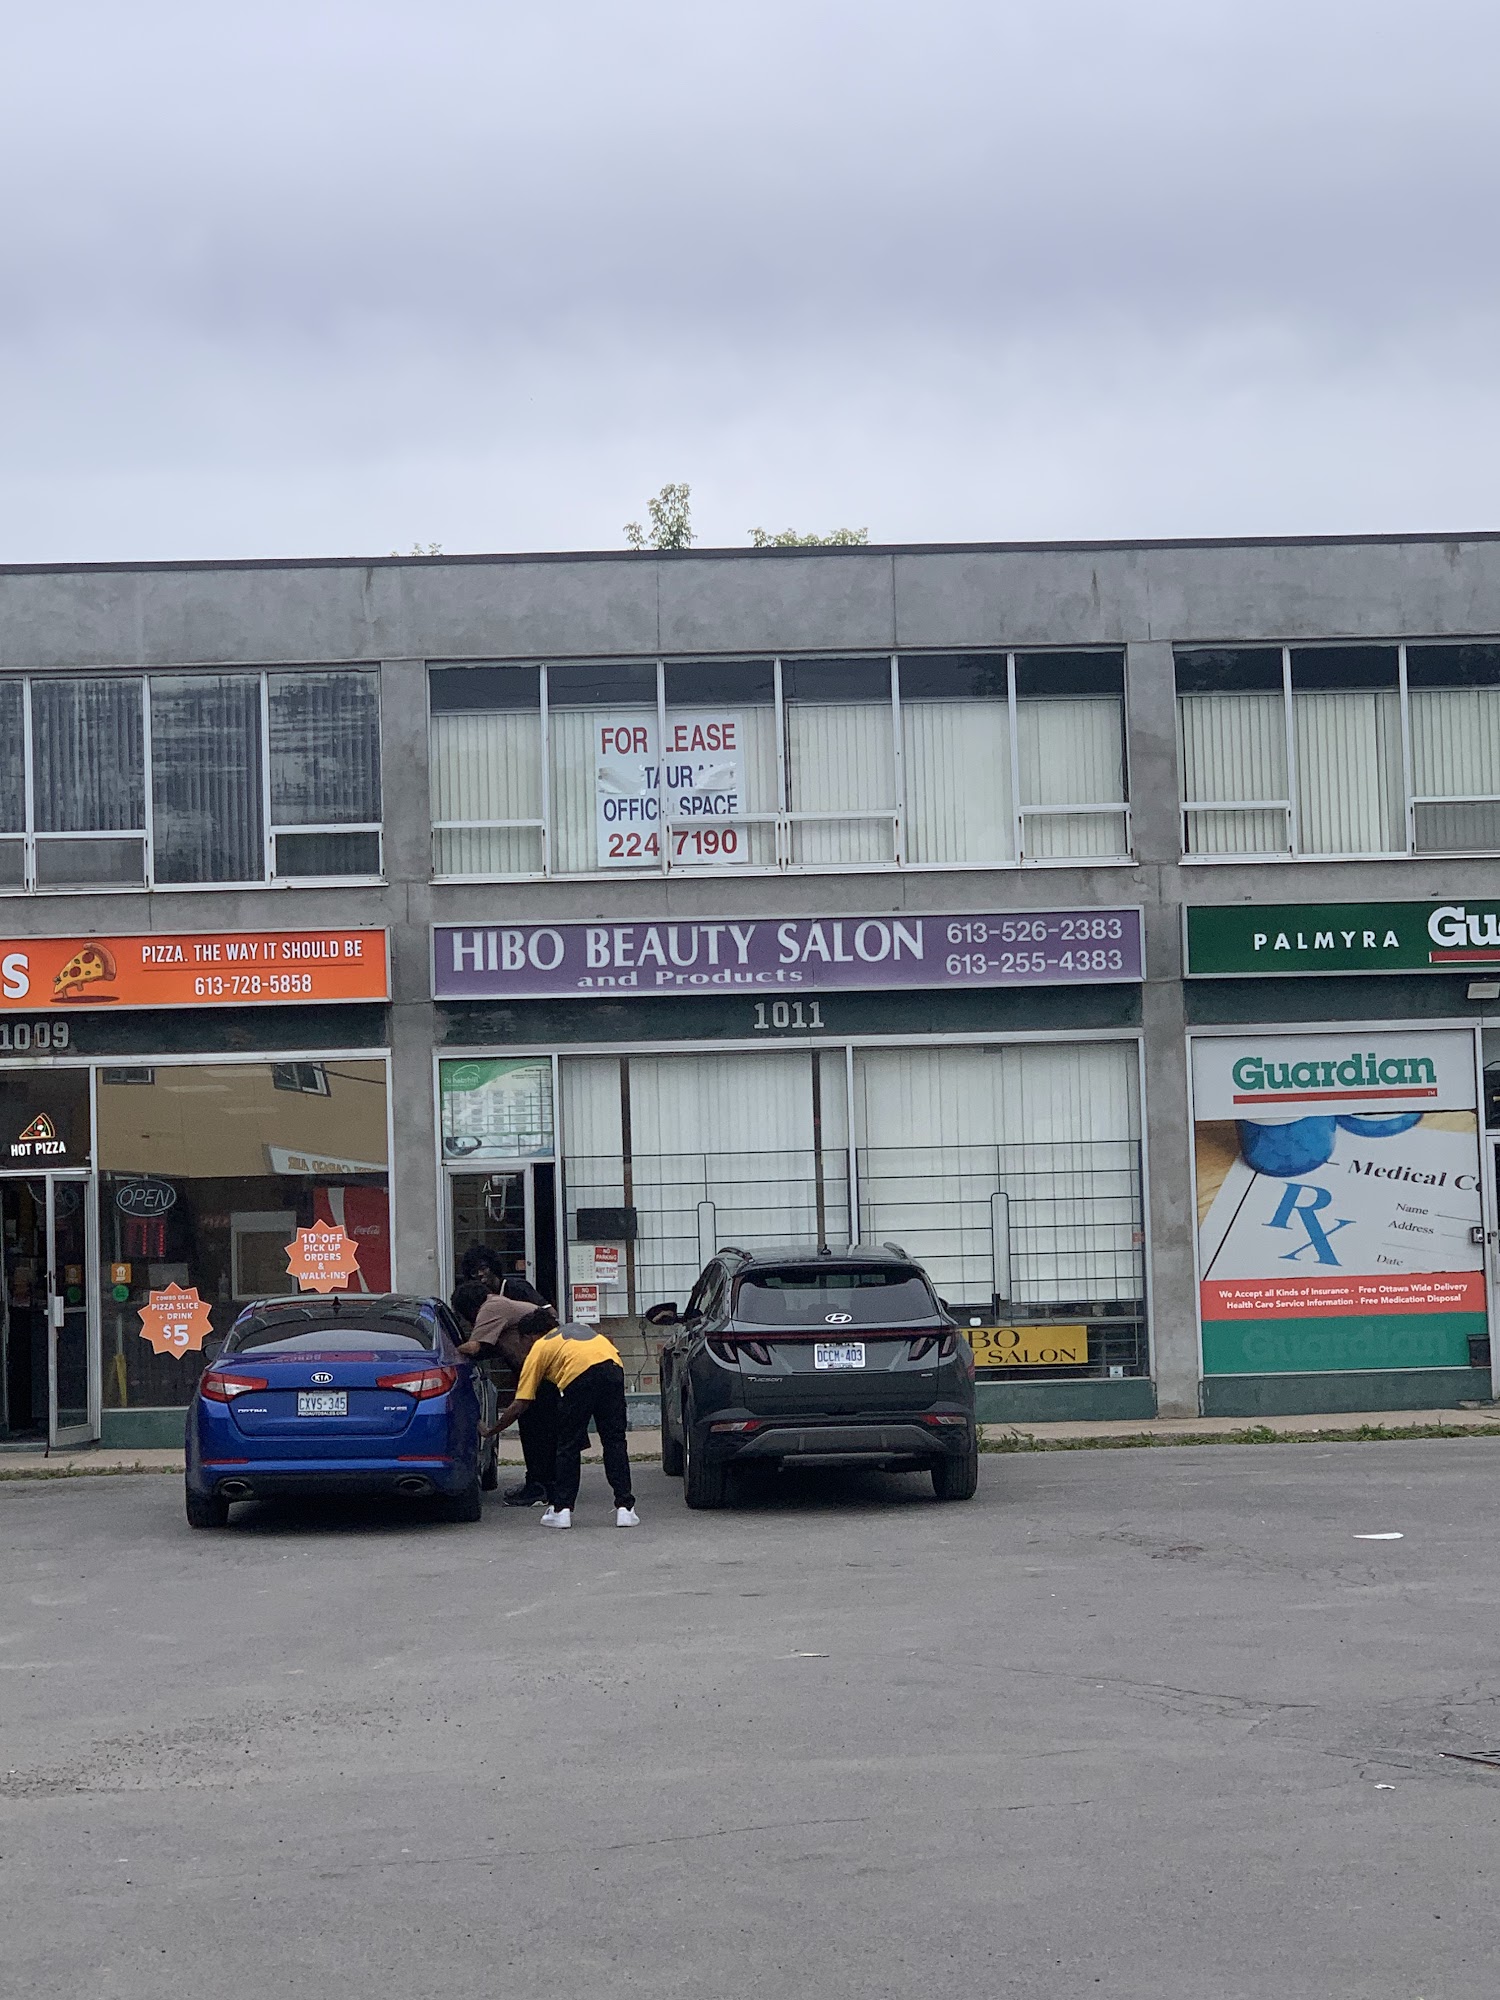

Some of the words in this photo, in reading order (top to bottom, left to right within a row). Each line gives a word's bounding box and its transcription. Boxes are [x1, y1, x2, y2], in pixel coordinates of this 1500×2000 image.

[601, 727, 648, 754] FOR
[603, 798, 662, 821] OFFIC
[679, 794, 739, 815] SPACE
[946, 918, 1124, 944] 613-526-2383
[1427, 906, 1500, 947] Gu
[452, 928, 565, 972] HIBO
[586, 925, 756, 969] BEAUTY
[777, 919, 924, 965] SALON
[1254, 930, 1400, 951] PALMYRA
[142, 945, 188, 963] PIZZA.
[193, 944, 221, 962] THE
[226, 943, 258, 961] WAY
[264, 942, 276, 960] IT
[282, 941, 339, 959] SHOULD
[344, 940, 363, 957] BE
[945, 950, 1124, 975] 613-255-4383
[2, 953, 30, 999] S
[194, 974, 313, 996] 613-728-5858
[577, 971, 638, 988] and
[655, 968, 803, 986] Products
[754, 1001, 825, 1030] 1011
[0, 1021, 69, 1050] 1009
[1232, 1053, 1437, 1090] Guardian
[11, 1143, 31, 1157] HOT
[35, 1141, 66, 1155] PIZZA
[1348, 1159, 1447, 1187] Medical
[120, 1189, 170, 1207] OPEN
[1396, 1203, 1429, 1215] Name
[1388, 1220, 1434, 1235] Address
[304, 1244, 325, 1252] PICK
[328, 1243, 341, 1251] UP
[304, 1253, 341, 1261] ORDERS
[317, 1262, 324, 1270] &
[1377, 1254, 1403, 1266] Date
[300, 1271, 346, 1280] WALK-INS
[1219, 1290, 1232, 1298] We
[1235, 1290, 1262, 1299] Accept
[1265, 1289, 1274, 1297] all
[1276, 1288, 1298, 1297] Kinds
[1301, 1287, 1310, 1295] of
[1311, 1287, 1349, 1295] Insurance
[1379, 1285, 1409, 1293] Ottawa
[1410, 1284, 1432, 1292] Wide
[1434, 1283, 1467, 1292] Delivery
[151, 1303, 174, 1311] PIZZA
[176, 1302, 199, 1310] SLICE
[1227, 1300, 1253, 1309] Health
[1255, 1300, 1274, 1308] Care
[1276, 1299, 1304, 1308] Service
[1307, 1298, 1353, 1306] Information
[1360, 1297, 1378, 1305] Free
[1381, 1295, 1425, 1304] Medication
[1427, 1294, 1461, 1303] Disposal
[167, 1312, 193, 1320] DRINK
[163, 1324, 189, 1346] $5
[988, 1348, 1076, 1364] SALON
[315, 1374, 330, 1382] KIA
